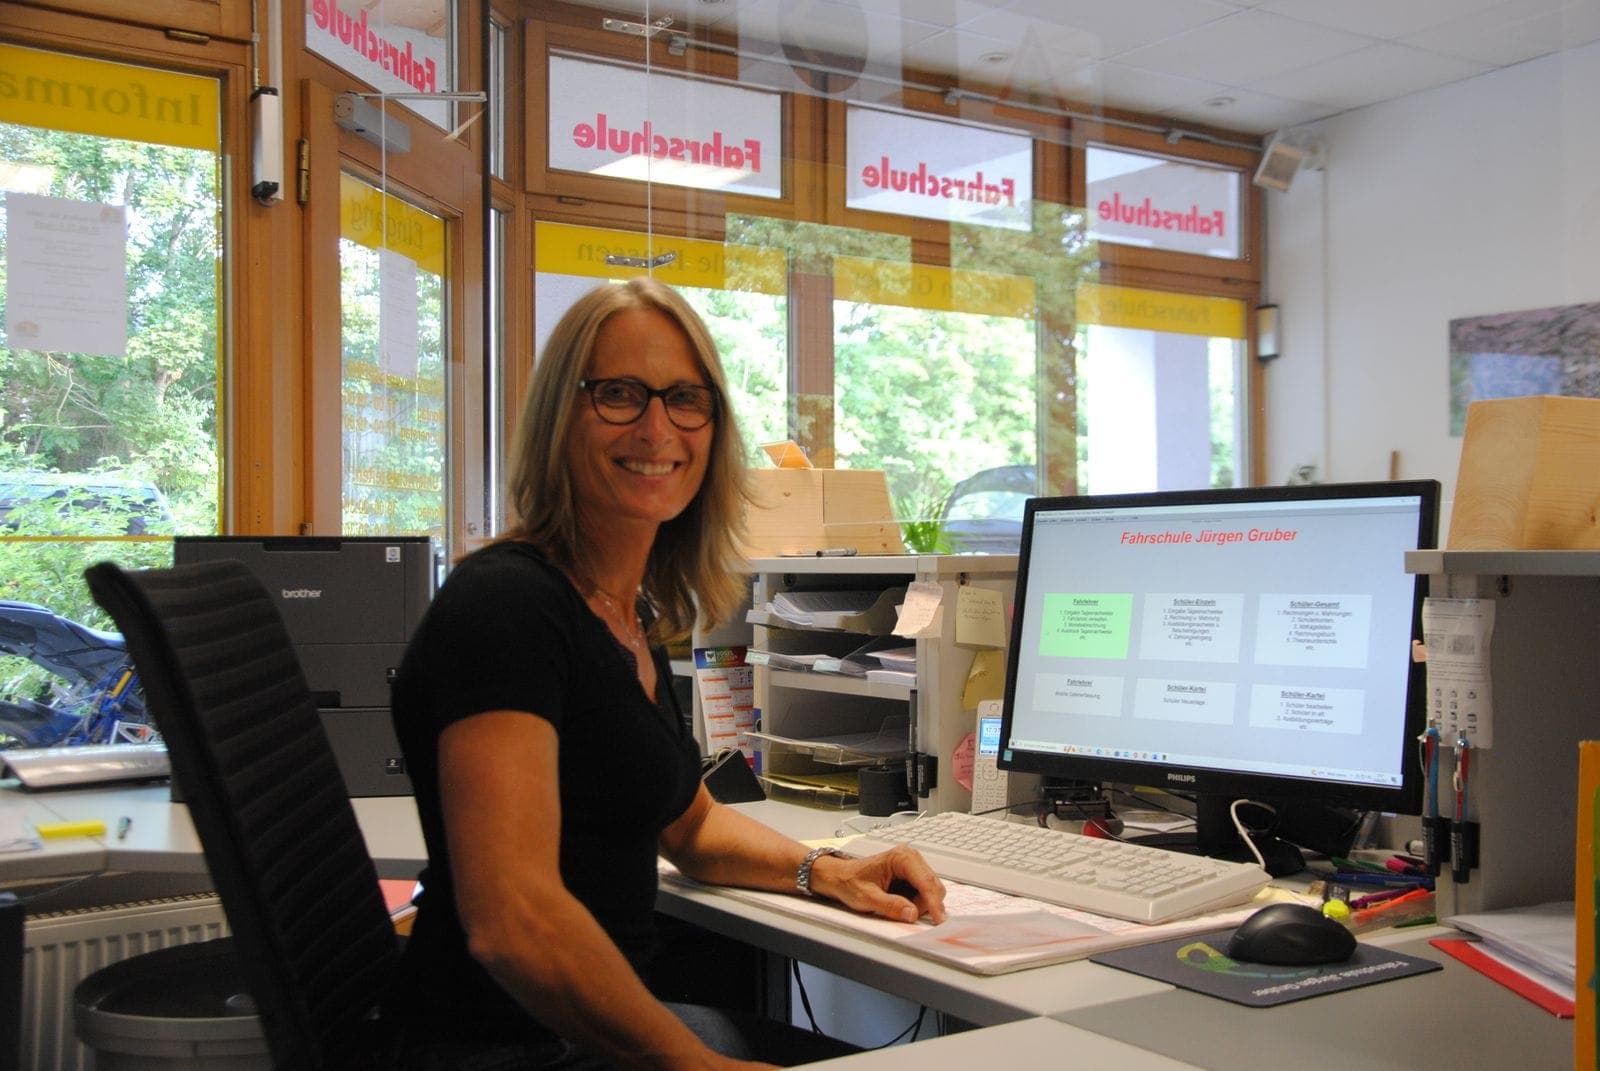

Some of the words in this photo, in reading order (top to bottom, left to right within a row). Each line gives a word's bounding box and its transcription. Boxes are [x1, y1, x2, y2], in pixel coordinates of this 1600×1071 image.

[1120, 530, 1192, 546] Fahrschule
[1195, 528, 1243, 546] Jürgen
[1247, 527, 1298, 543] Gruber
[282, 588, 322, 598] brother
[1167, 773, 1196, 783] PHILIPS
